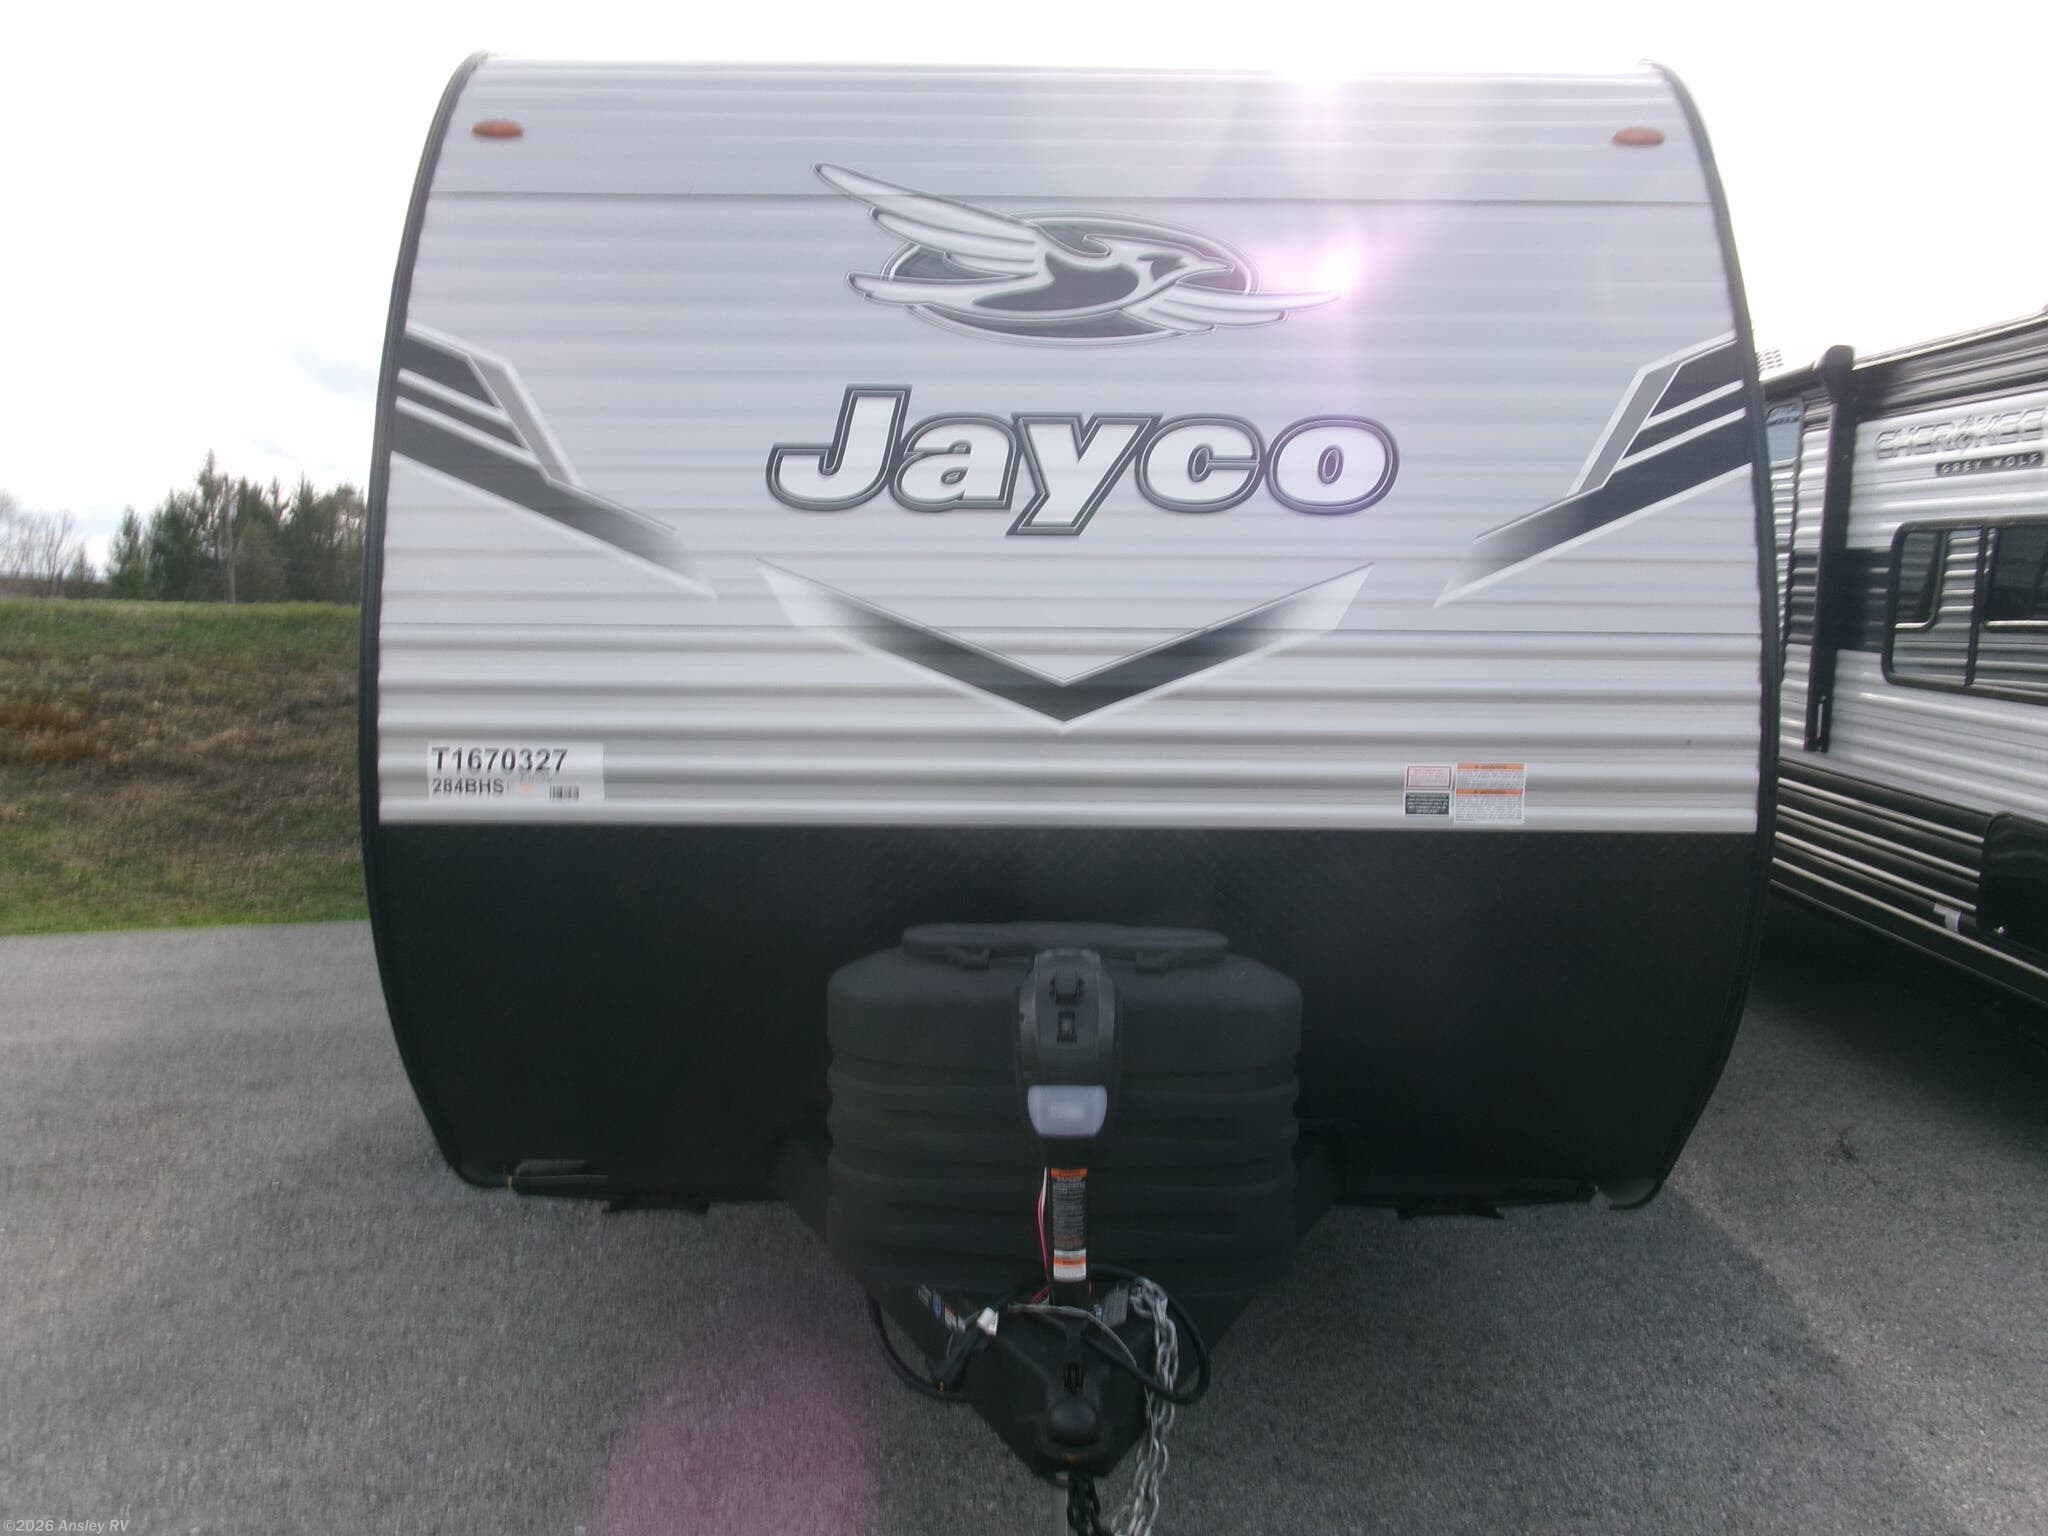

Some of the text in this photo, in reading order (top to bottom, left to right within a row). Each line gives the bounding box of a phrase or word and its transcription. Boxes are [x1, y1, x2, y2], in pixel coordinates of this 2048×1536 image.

[765, 383, 1400, 537] Jayco
[1941, 452, 2040, 475] GREY WOLF
[431, 746, 568, 774] T1670327
[432, 777, 504, 794] 284BHS
